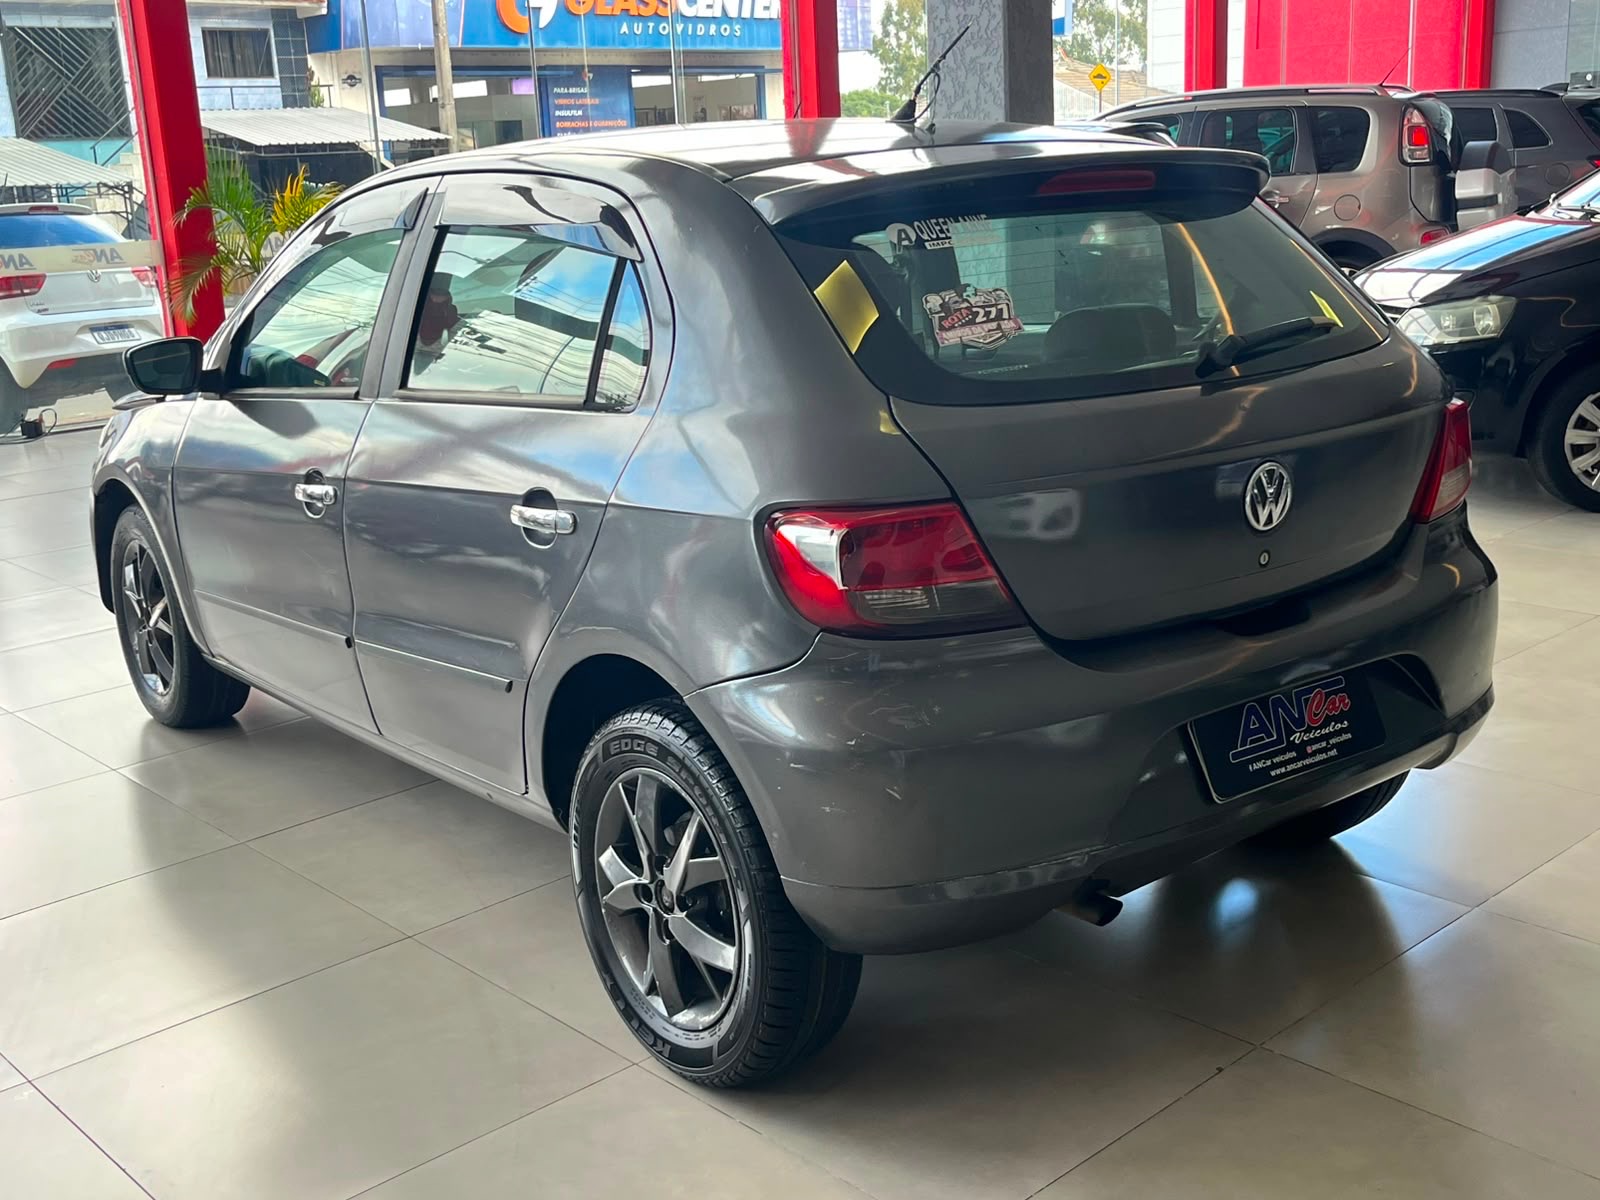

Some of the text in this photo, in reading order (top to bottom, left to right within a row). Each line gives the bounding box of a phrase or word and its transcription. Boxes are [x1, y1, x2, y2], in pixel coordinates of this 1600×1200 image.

[620, 22, 742, 37] AUTOVIDROS
[555, 109, 583, 117] INSULFILM
[913, 216, 959, 241] QUEEN
[942, 308, 971, 328] ROTA
[972, 303, 1010, 322] 277
[609, 739, 659, 756] EDGE
[1269, 748, 1339, 777] www.ancarveiculos.net
